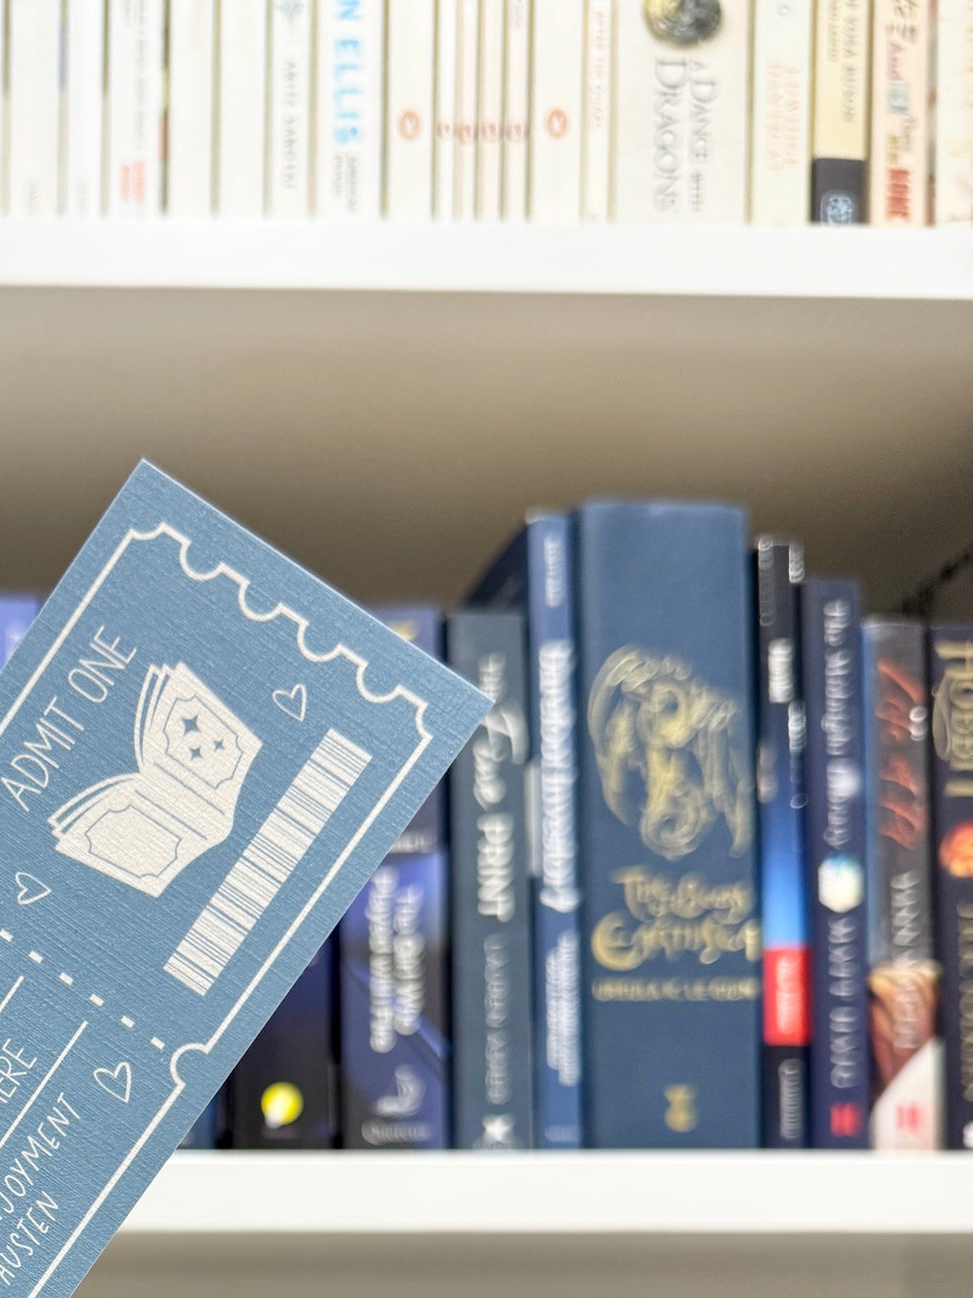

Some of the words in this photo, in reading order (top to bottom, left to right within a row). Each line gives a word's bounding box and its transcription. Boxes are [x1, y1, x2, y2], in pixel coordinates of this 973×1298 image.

[332, 38, 364, 145] ELLIS
[651, 57, 688, 214] DRAGONS
[1, 697, 84, 811] ADMIT
[68, 626, 136, 702] ONE
[476, 812, 517, 923] PRINT
